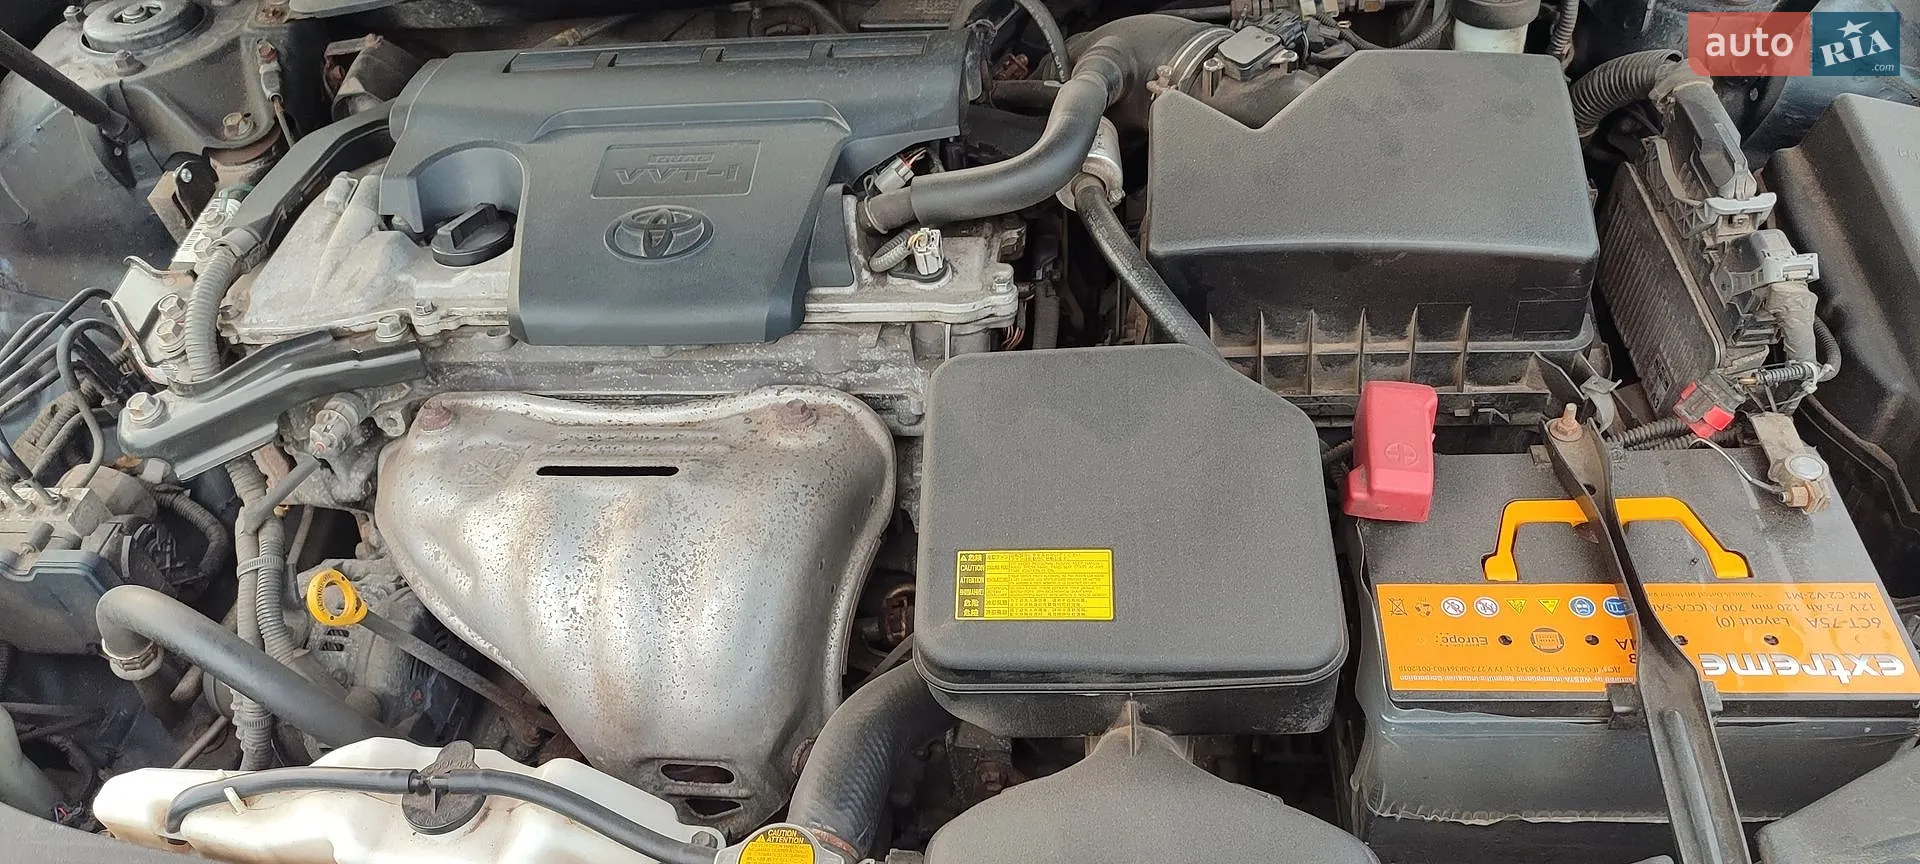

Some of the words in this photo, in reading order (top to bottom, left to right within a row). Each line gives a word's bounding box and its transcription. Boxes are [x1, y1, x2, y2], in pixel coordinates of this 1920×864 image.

[960, 564, 985, 572] CAUTION
[960, 576, 985, 584] ATTENTION
[1739, 614, 1791, 628] Layout
[1441, 634, 1489, 646] Europe
[1697, 653, 1905, 685] extreme
[767, 829, 798, 838] CAUTION
[766, 836, 805, 844] ATTENTION
